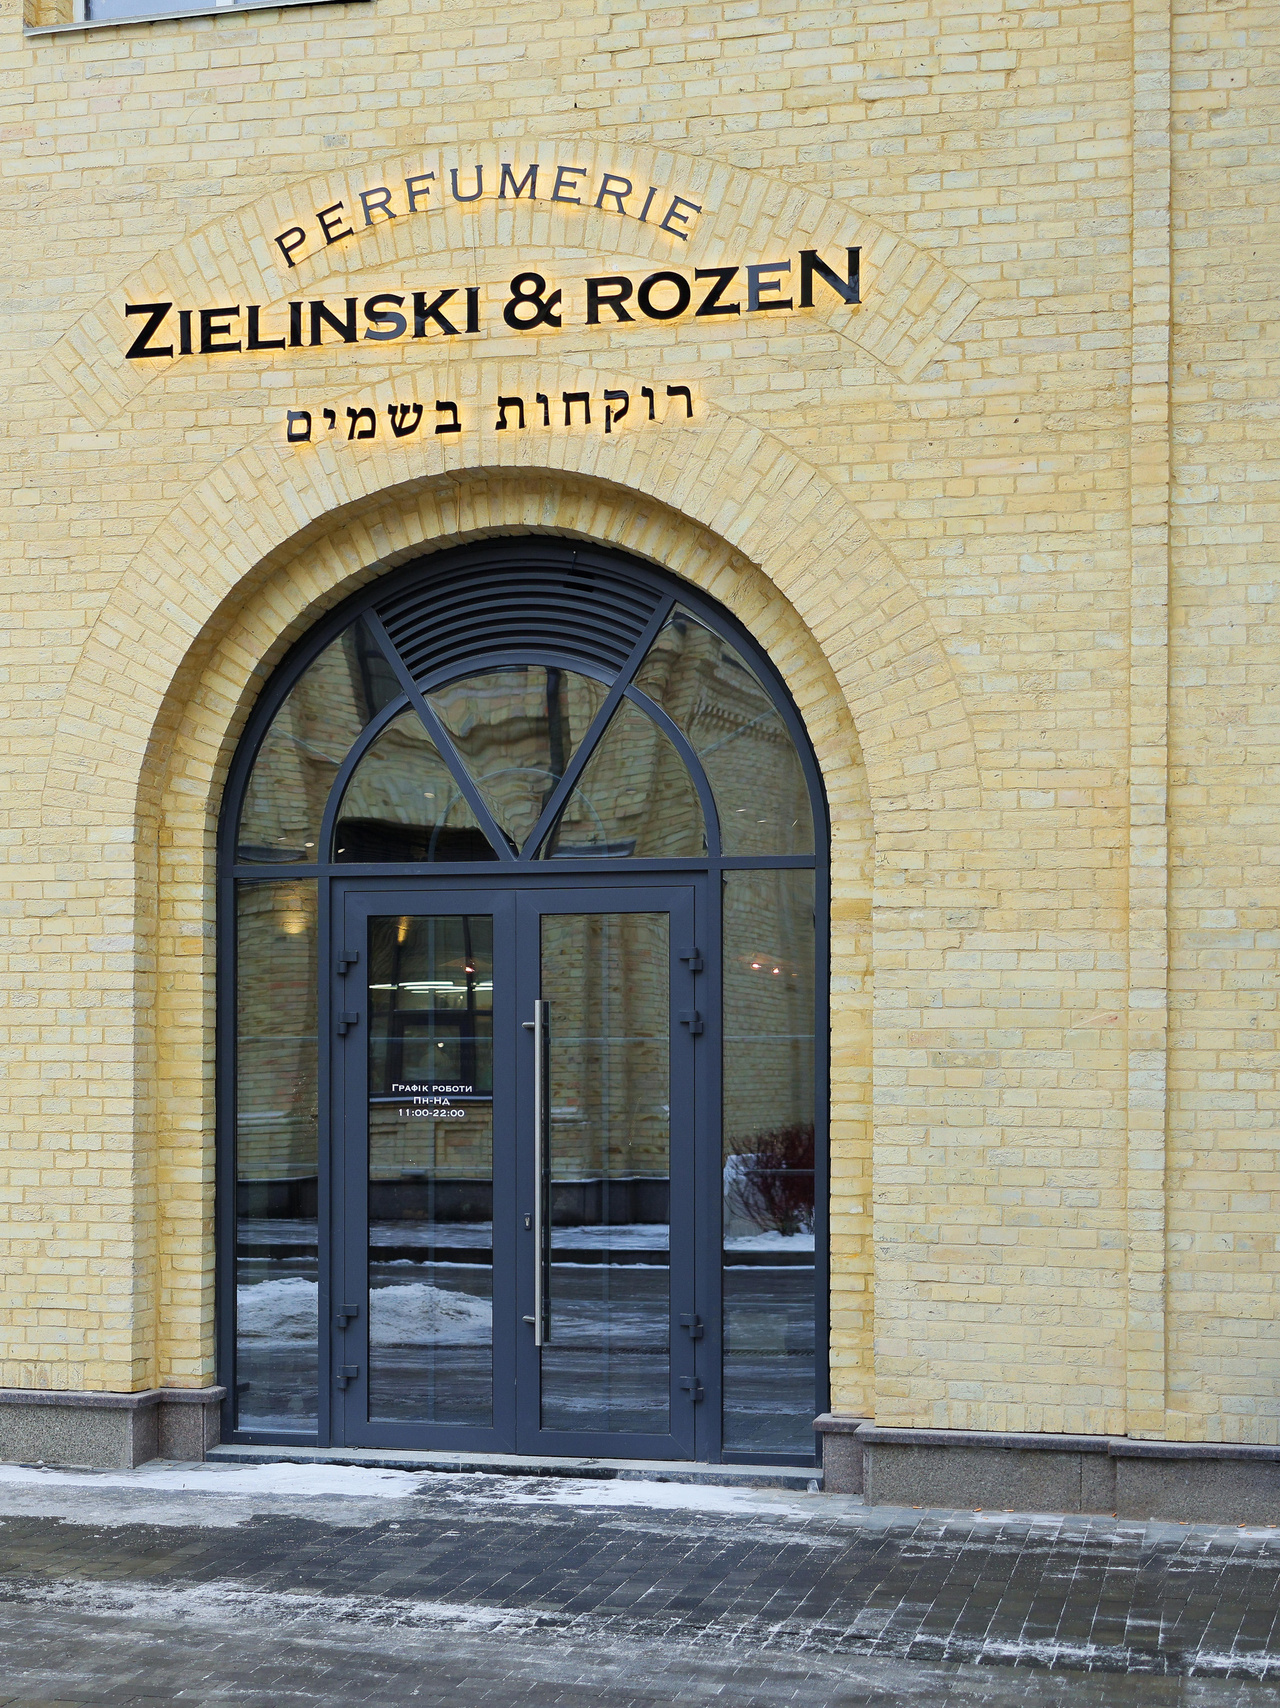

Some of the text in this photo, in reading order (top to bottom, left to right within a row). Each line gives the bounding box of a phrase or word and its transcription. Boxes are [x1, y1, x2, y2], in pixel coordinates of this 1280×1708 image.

[274, 163, 703, 268] PERFUMERIE
[125, 246, 863, 359] ZIELINSKI & ROZEN
[287, 382, 694, 443] רוקחות בשמים
[398, 1108, 465, 1117] 11:00-22:00
